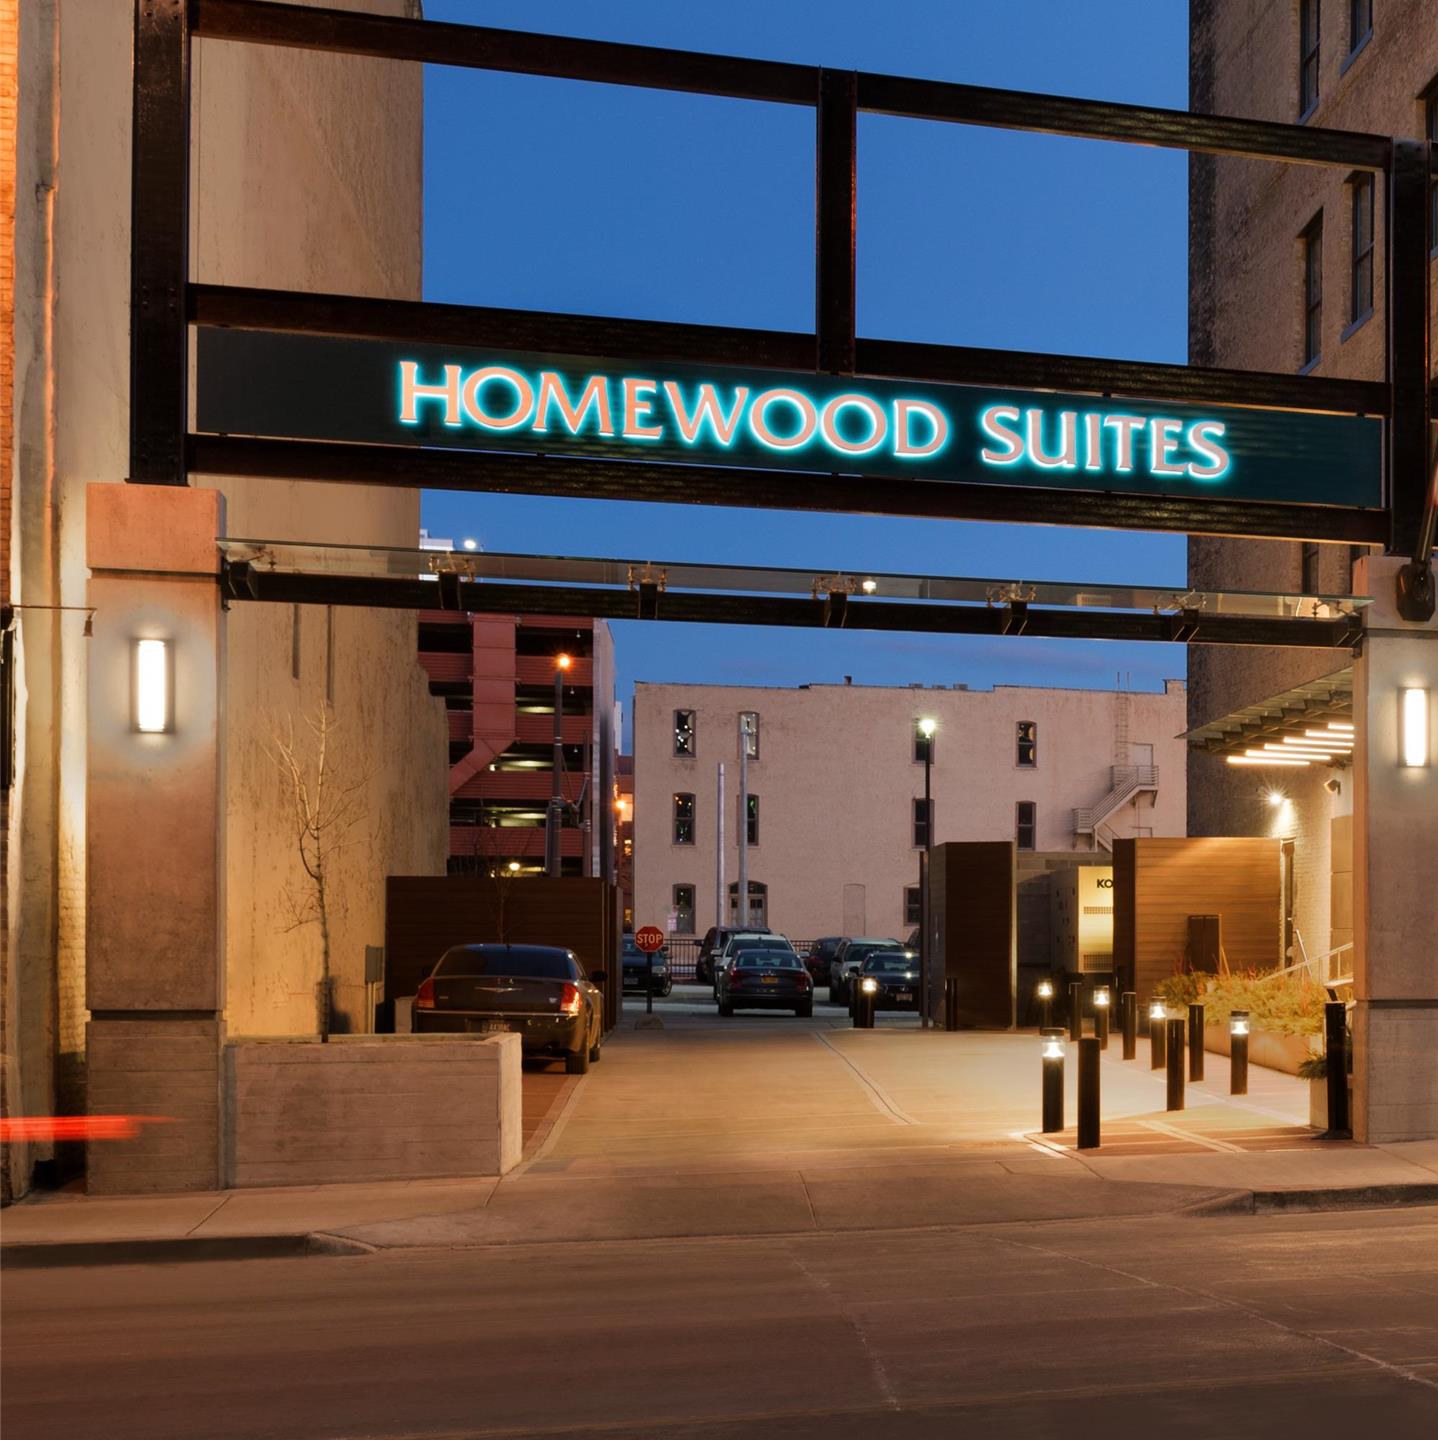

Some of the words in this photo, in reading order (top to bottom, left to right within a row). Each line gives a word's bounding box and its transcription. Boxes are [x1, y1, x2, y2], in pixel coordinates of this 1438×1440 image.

[398, 360, 950, 458] HOMEWOOD
[981, 404, 1232, 479] SUITES
[636, 933, 663, 944] STOP
